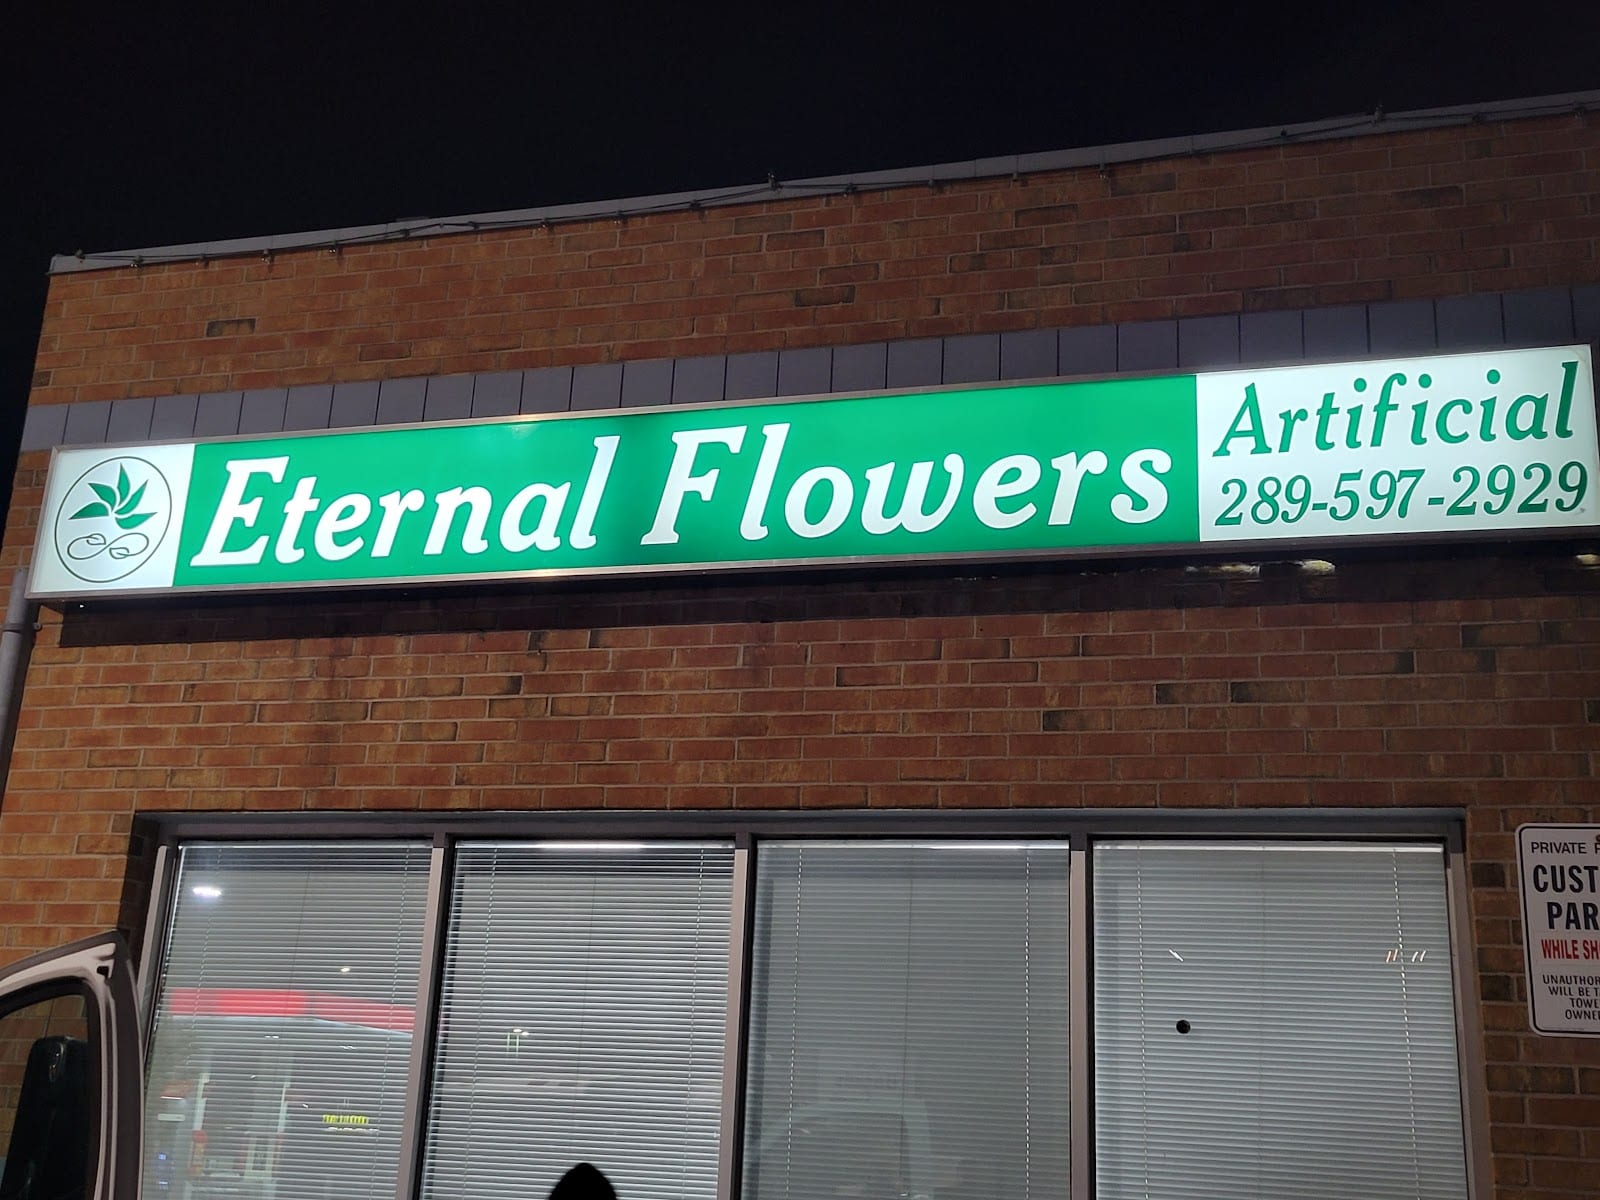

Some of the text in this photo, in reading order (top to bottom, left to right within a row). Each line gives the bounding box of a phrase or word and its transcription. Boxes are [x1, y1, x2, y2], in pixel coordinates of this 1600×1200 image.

[1212, 361, 1578, 457] Artificial
[190, 422, 1172, 567] Eternal Flowers
[1214, 460, 1588, 526] 289-597-2929
[1531, 842, 1586, 854] PRIVATE
[1533, 865, 1599, 893] CUST
[1547, 902, 1600, 930] PAR
[1541, 939, 1600, 960] WHILE SH
[1548, 986, 1600, 997] WILL BE T
